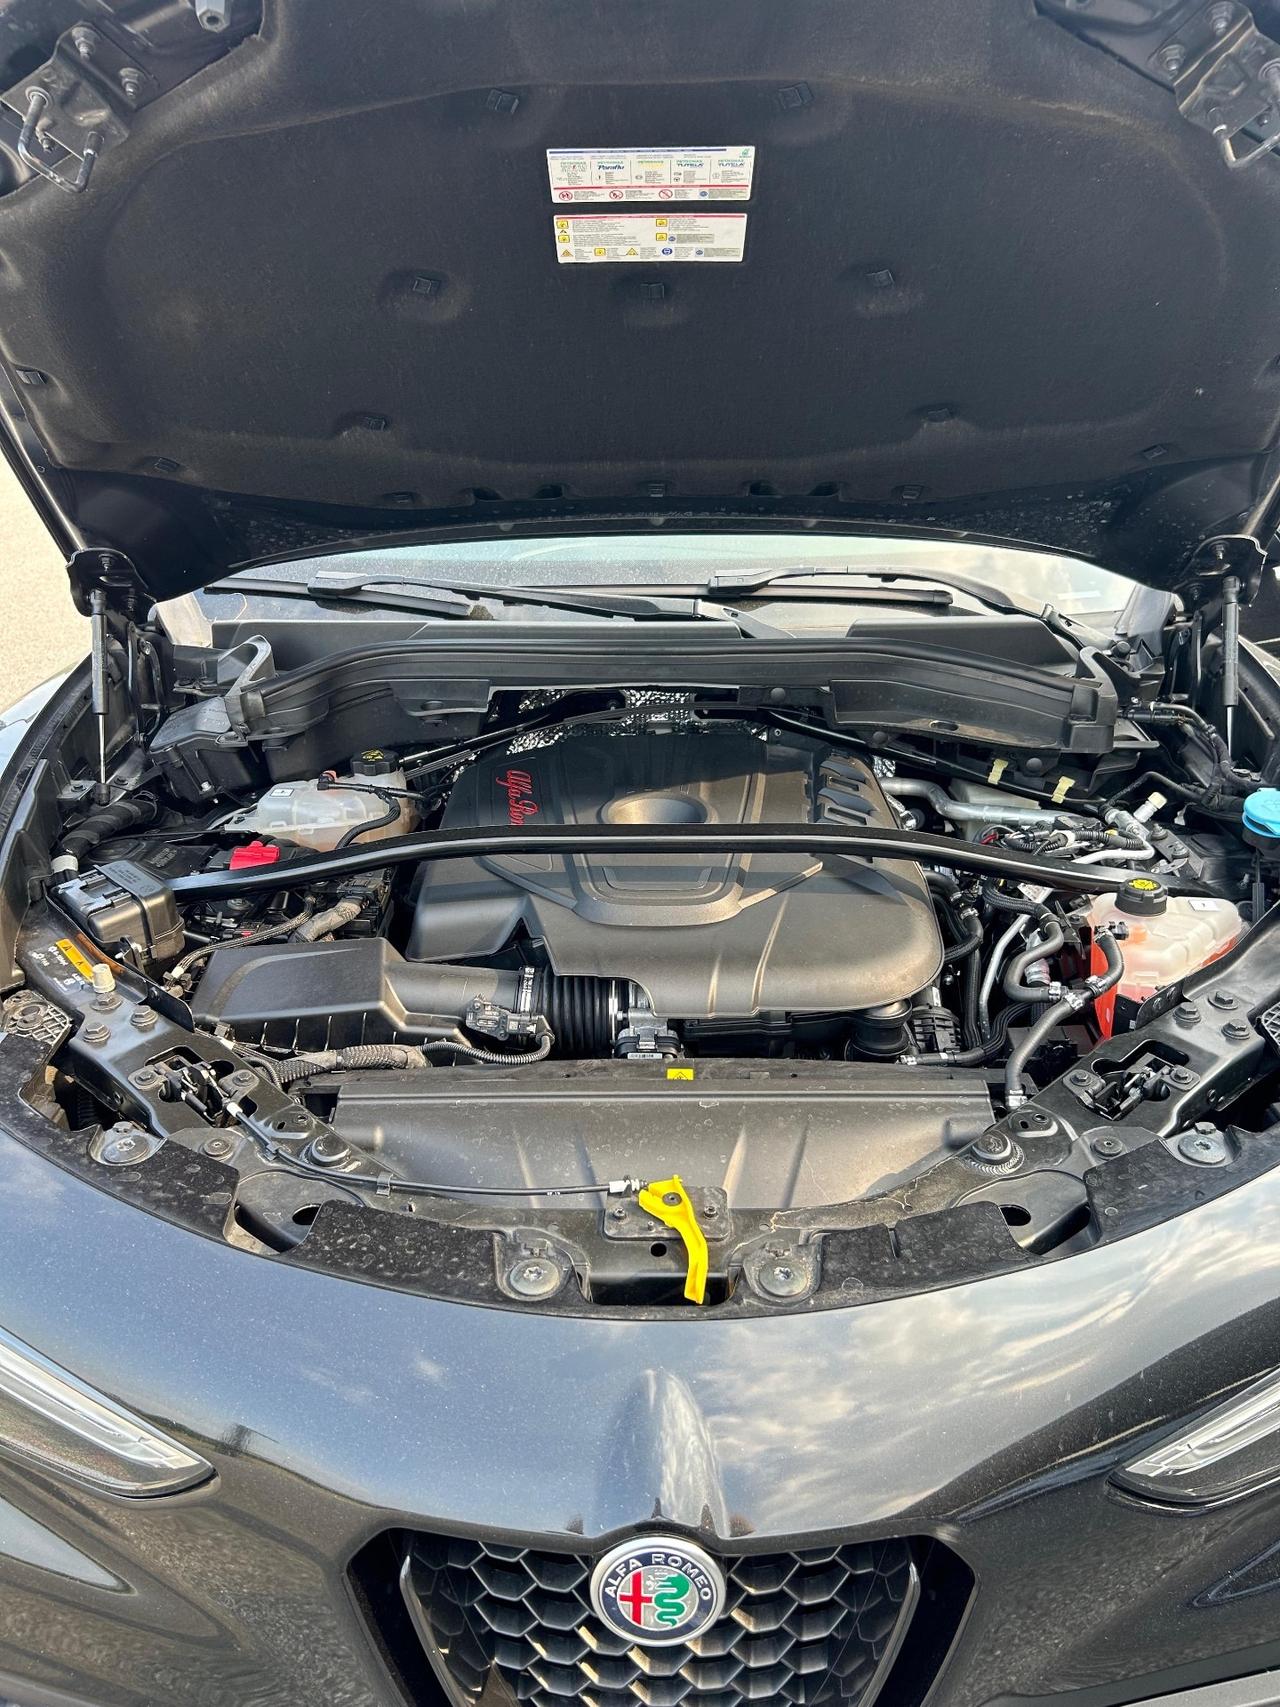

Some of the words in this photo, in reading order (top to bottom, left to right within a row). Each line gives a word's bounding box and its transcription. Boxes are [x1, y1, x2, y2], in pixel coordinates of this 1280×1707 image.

[496, 770, 533, 799] Alfa
[605, 1558, 643, 1598] ALFA
[651, 1553, 712, 1601] ROMEO
